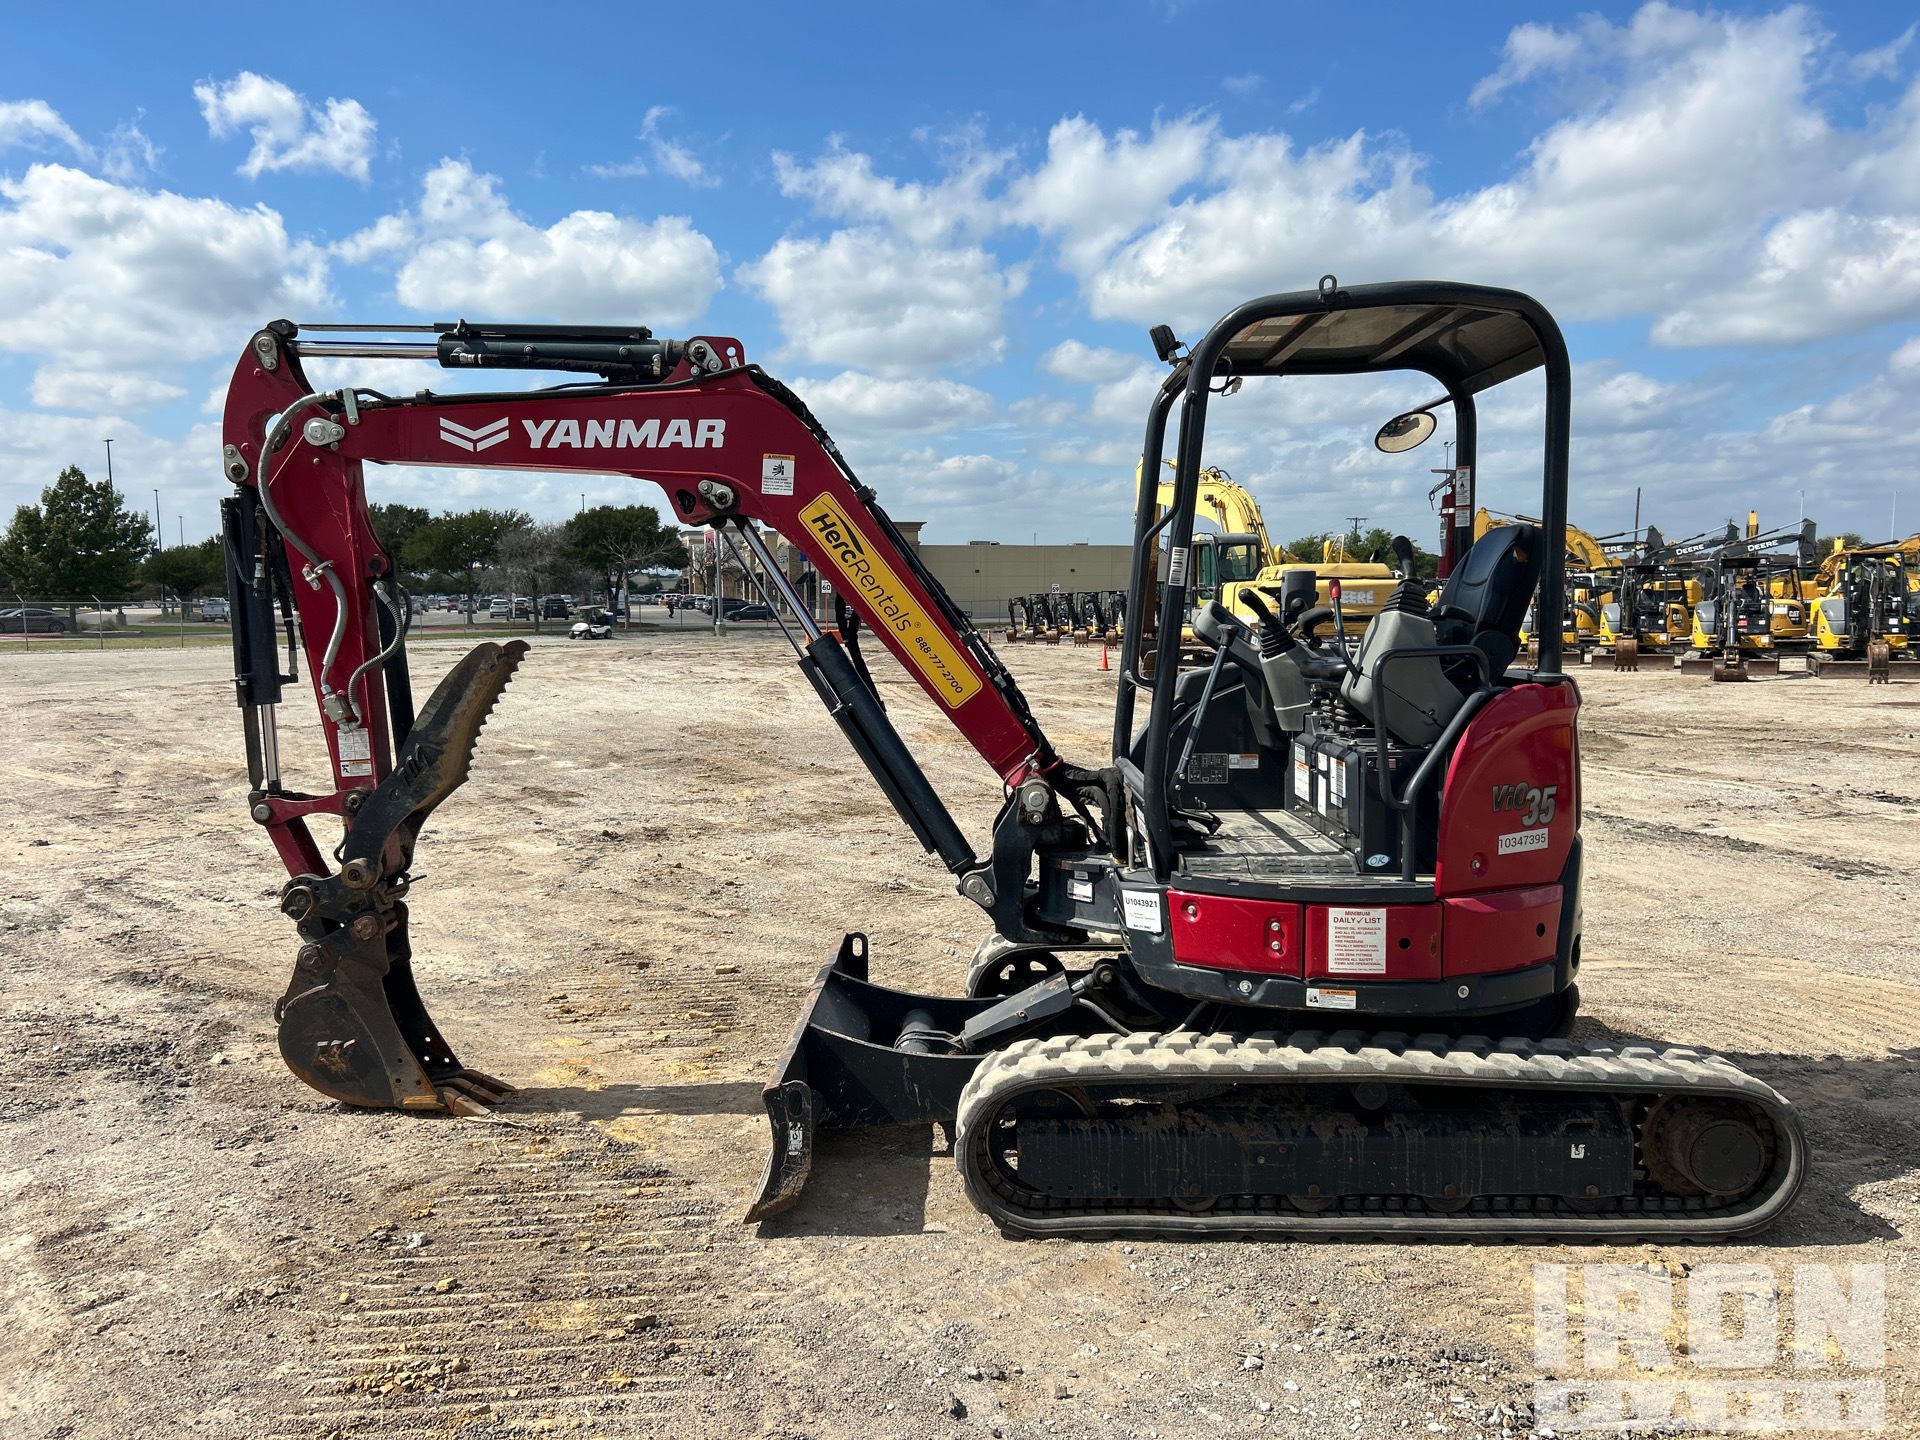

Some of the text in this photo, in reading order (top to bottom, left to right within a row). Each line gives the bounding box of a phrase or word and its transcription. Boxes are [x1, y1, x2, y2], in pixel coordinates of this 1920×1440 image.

[521, 418, 726, 449] YANMAR
[1676, 543, 1705, 556] DEERE
[1747, 539, 1779, 552] DEERE
[1329, 590, 1374, 604] EERE
[1788, 610, 1800, 618] CAT
[914, 635, 964, 695] 888-777-2700
[1499, 832, 1547, 849] 10347395
[1369, 855, 1386, 866] OK
[1125, 897, 1158, 908] U1043921
